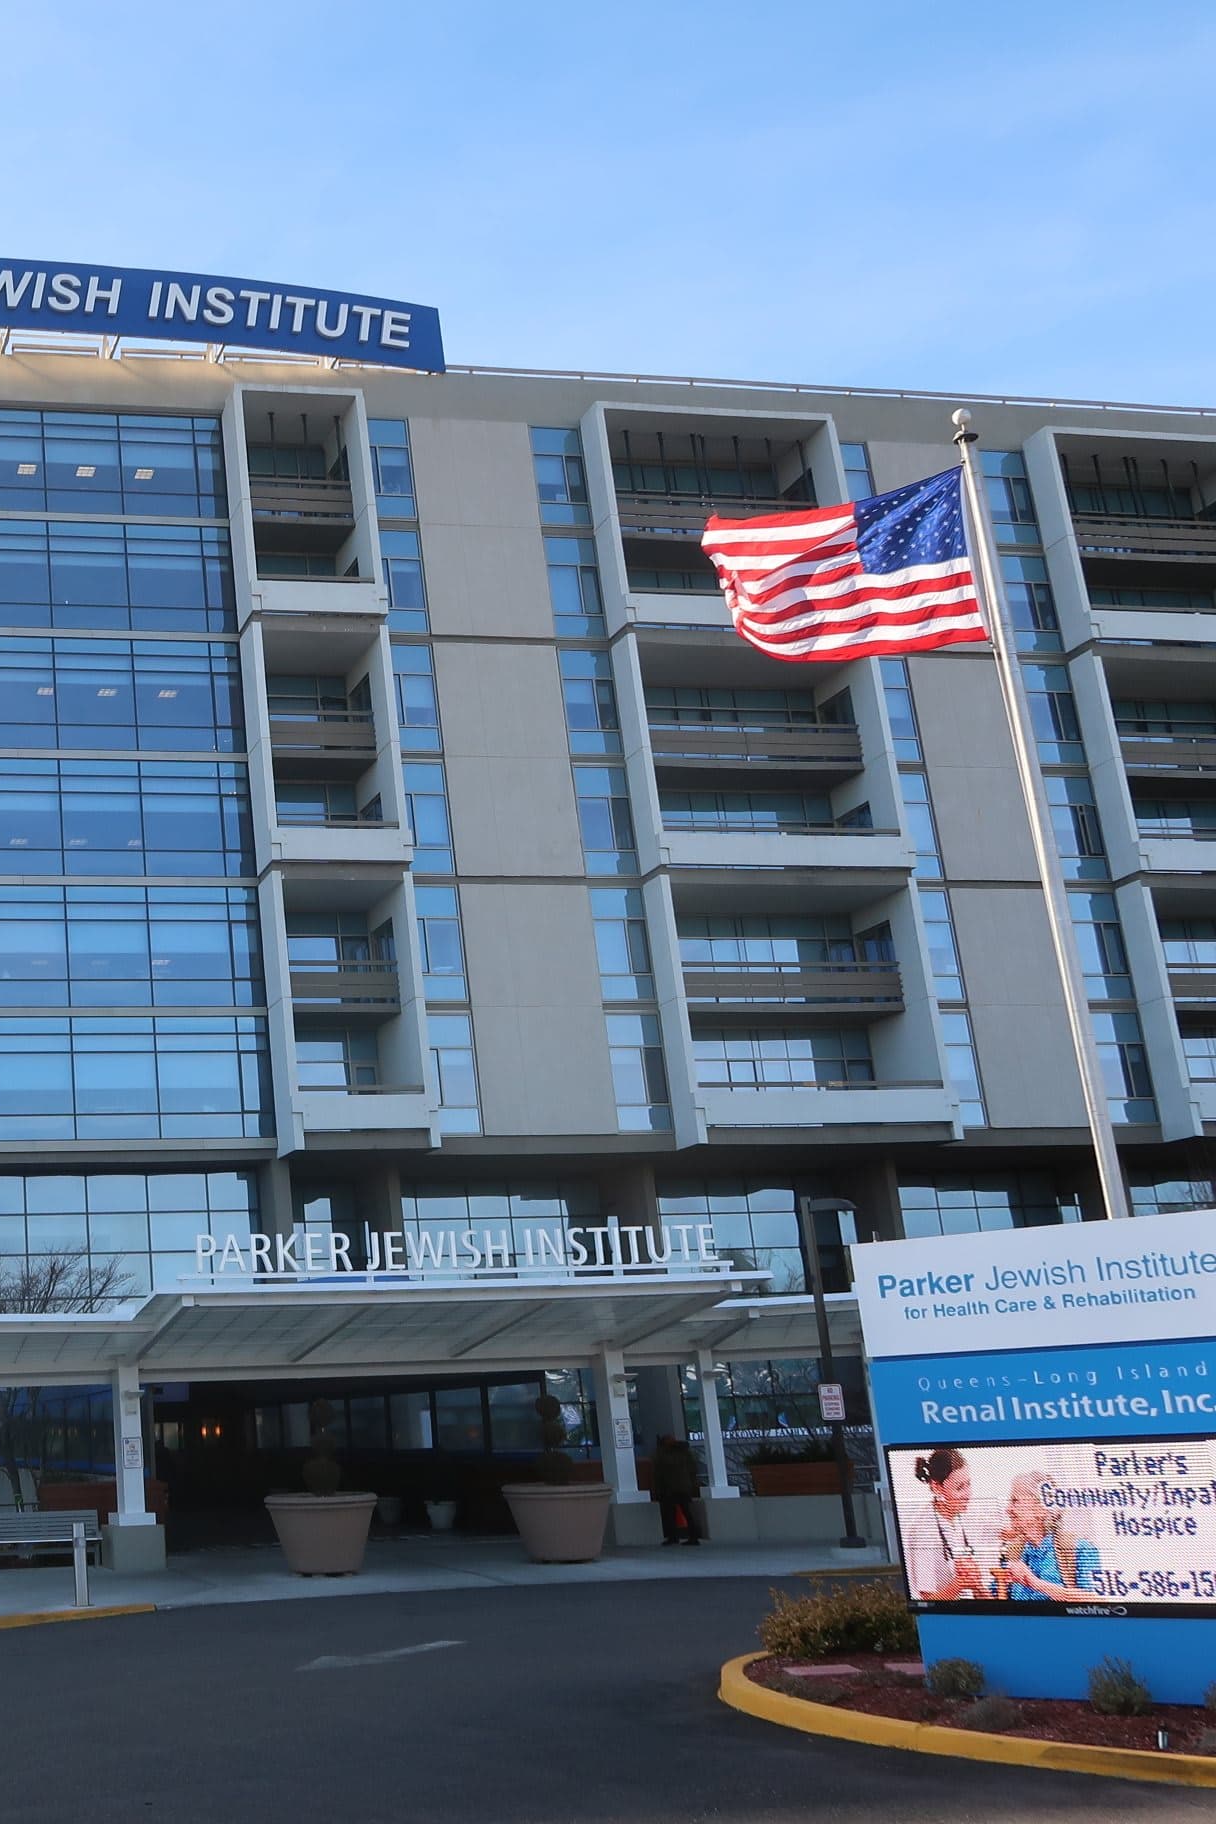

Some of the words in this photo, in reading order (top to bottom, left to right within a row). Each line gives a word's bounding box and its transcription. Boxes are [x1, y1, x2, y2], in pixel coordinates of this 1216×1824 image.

[148, 280, 412, 349] INSTITUTE
[195, 1231, 354, 1274] PARKER
[365, 1225, 511, 1272] JEWISH
[524, 1223, 719, 1268] INSTITUTE
[878, 1271, 975, 1299] Parker
[985, 1258, 1085, 1292] Jewish
[1095, 1249, 1216, 1283] Institute
[904, 1306, 928, 1320] for
[934, 1300, 990, 1319] Health
[995, 1298, 1037, 1314] Care
[1043, 1296, 1057, 1310] &
[1062, 1286, 1197, 1309] Rehabilitation
[1116, 1360, 1209, 1381] Island
[921, 1395, 1006, 1425] Renal
[1011, 1392, 1158, 1423] Institute,
[1094, 1450, 1189, 1476] Parker's
[1112, 1510, 1198, 1539] Hospice
[1091, 1570, 1216, 1597] 516-586-15
[1065, 1606, 1112, 1616] watchfire
